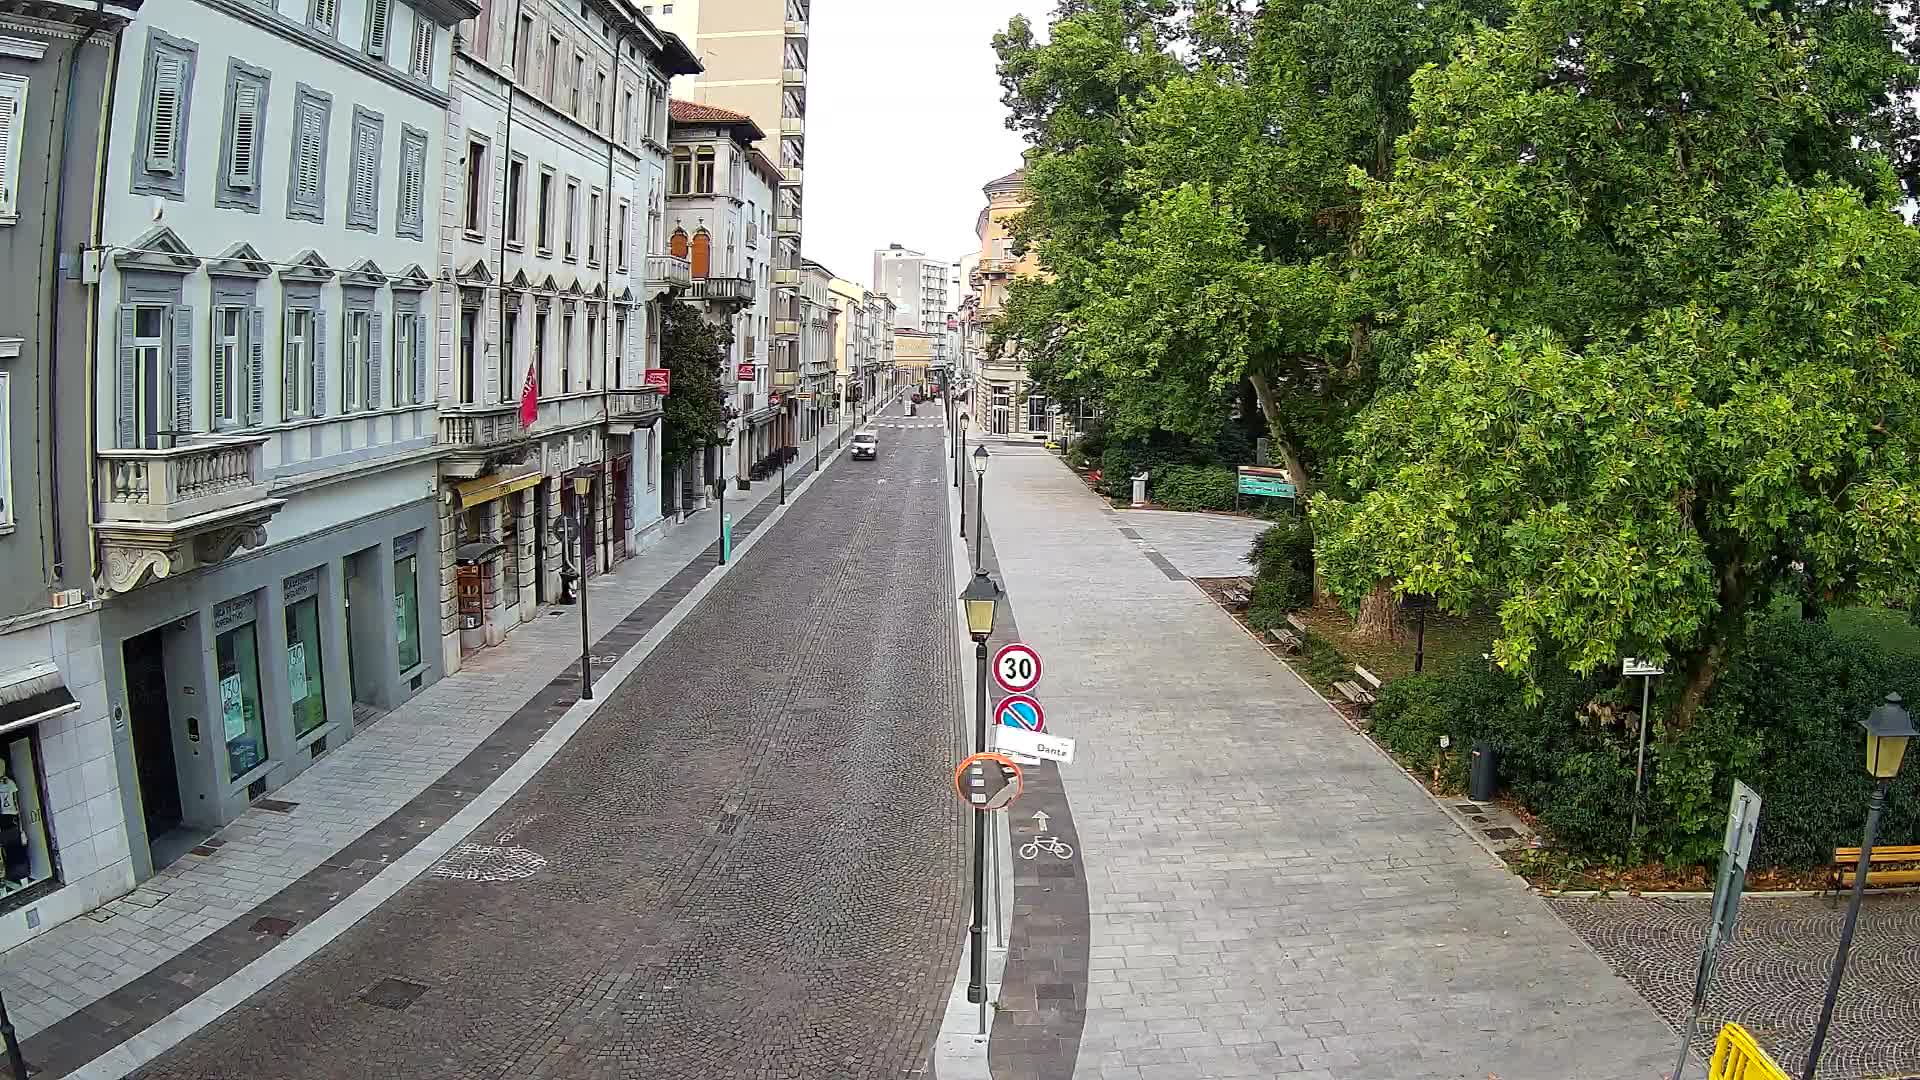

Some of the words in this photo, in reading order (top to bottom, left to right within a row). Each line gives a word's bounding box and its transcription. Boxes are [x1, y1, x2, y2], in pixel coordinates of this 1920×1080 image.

[1004, 657, 1032, 680] 30
[222, 679, 240, 701] 130
[1037, 742, 1068, 757] Dante
